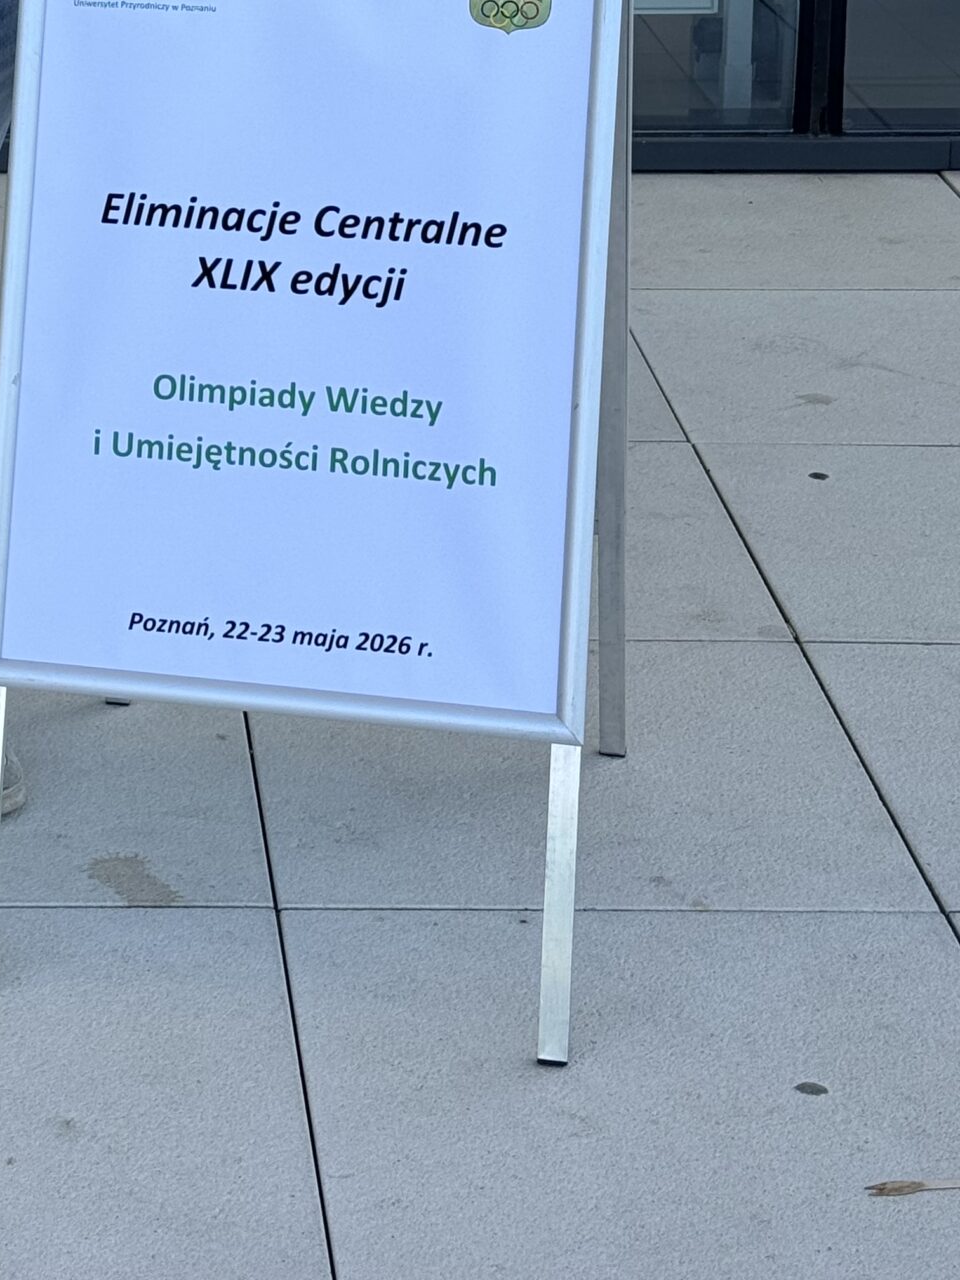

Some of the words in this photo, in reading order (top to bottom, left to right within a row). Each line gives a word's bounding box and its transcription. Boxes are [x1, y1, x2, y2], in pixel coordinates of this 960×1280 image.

[74, 0, 119, 9] Uniwersytet
[120, 0, 169, 12] Przyrodniczy
[181, 3, 216, 12] Poznaniu
[101, 192, 301, 241] Eliminacje
[314, 205, 507, 248] Centralne
[191, 256, 282, 292] XLIX
[290, 263, 407, 308] edycji
[153, 374, 316, 416] Olimpiady
[325, 385, 443, 426] Wiedzy
[93, 429, 101, 455] i
[112, 431, 319, 471] Umiejętności
[329, 447, 497, 489] Rolniczych
[128, 612, 214, 641] Poznań,
[222, 620, 286, 643] 22-23
[291, 628, 349, 652] maja
[355, 632, 412, 655] 2026
[417, 642, 432, 657] r.
